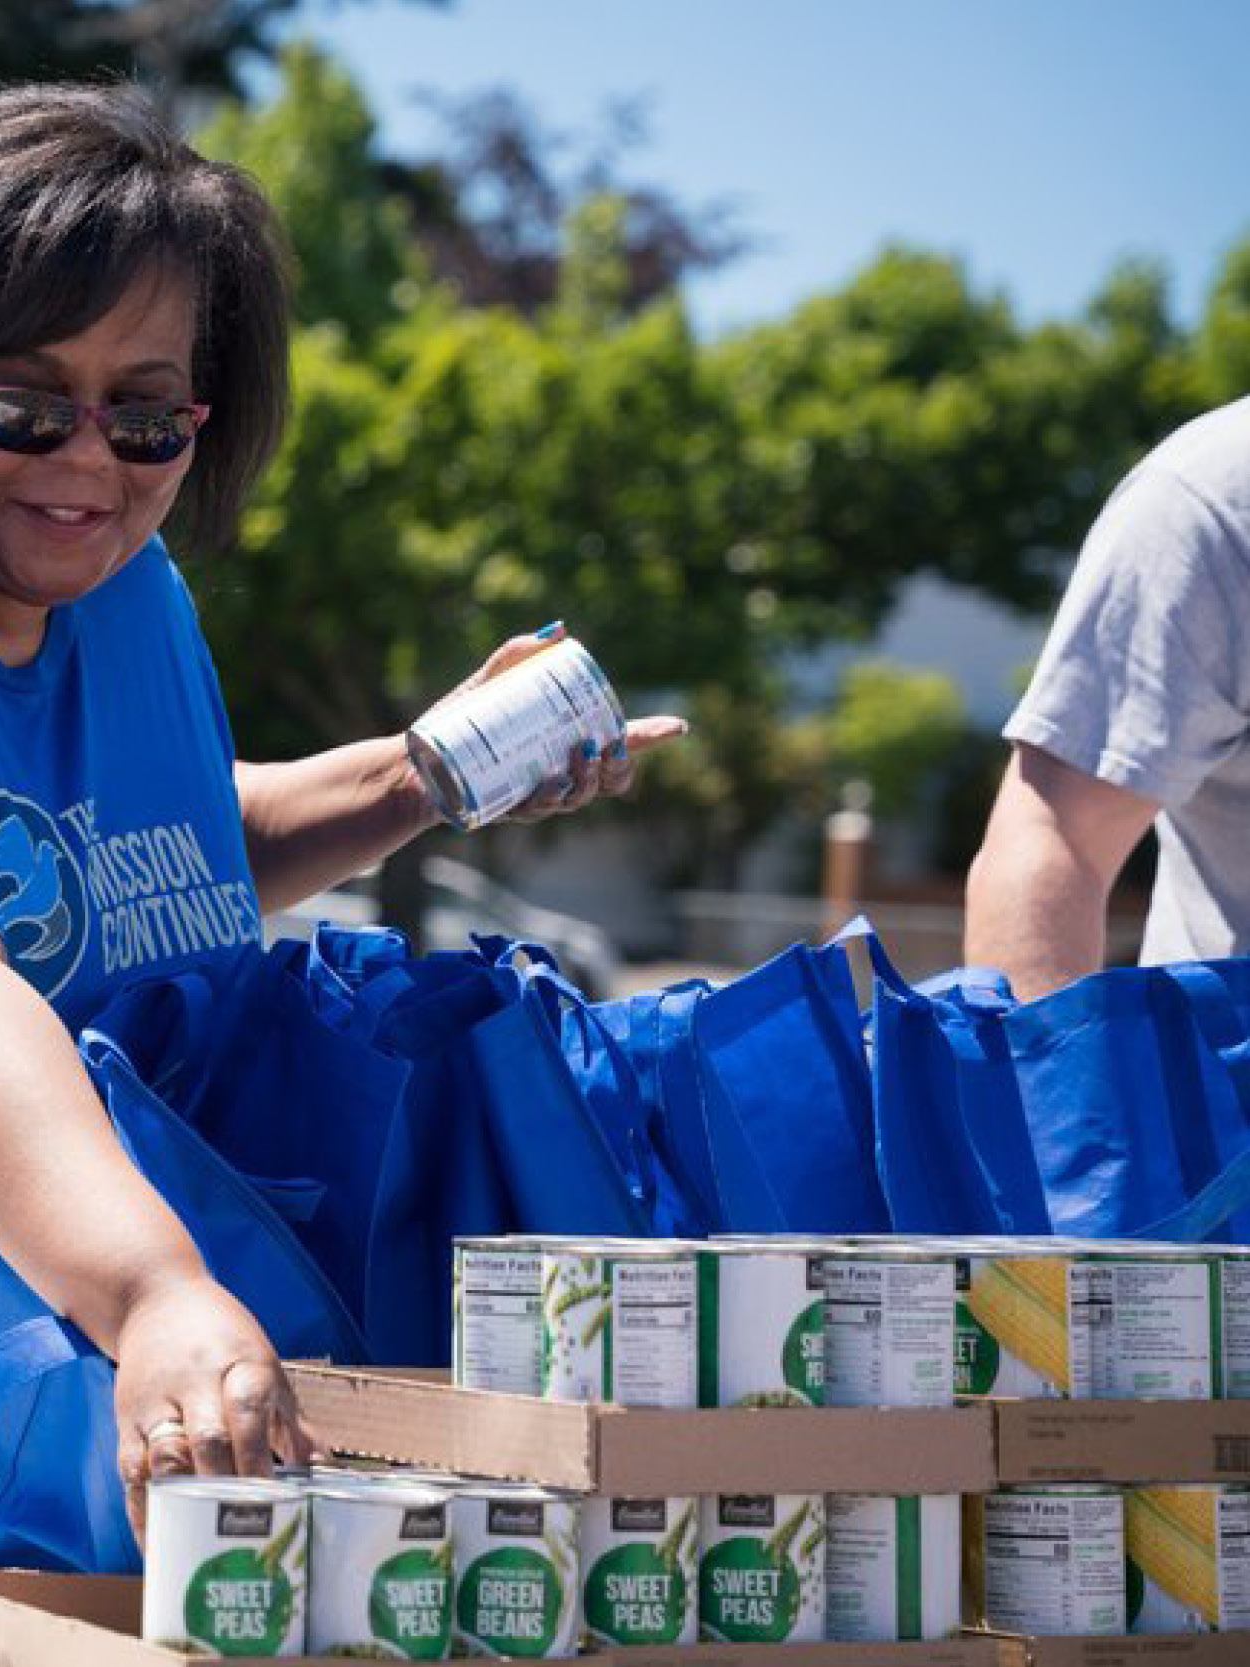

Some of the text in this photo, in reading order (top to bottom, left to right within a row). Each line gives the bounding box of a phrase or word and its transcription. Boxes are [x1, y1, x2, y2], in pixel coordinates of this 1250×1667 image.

[87, 822, 214, 911] MISSION
[101, 880, 260, 976] CONTINUES
[205, 1579, 271, 1609] SWEET
[385, 1578, 447, 1609] SWEET
[477, 1579, 545, 1609] GREEN
[605, 1573, 673, 1602] SWEET
[712, 1566, 780, 1597] SWEET
[214, 1609, 267, 1639] PEAS
[396, 1609, 442, 1638] PEAS
[476, 1609, 544, 1638] BEANS
[613, 1603, 666, 1631] PEAS
[721, 1598, 775, 1626] PEAS
